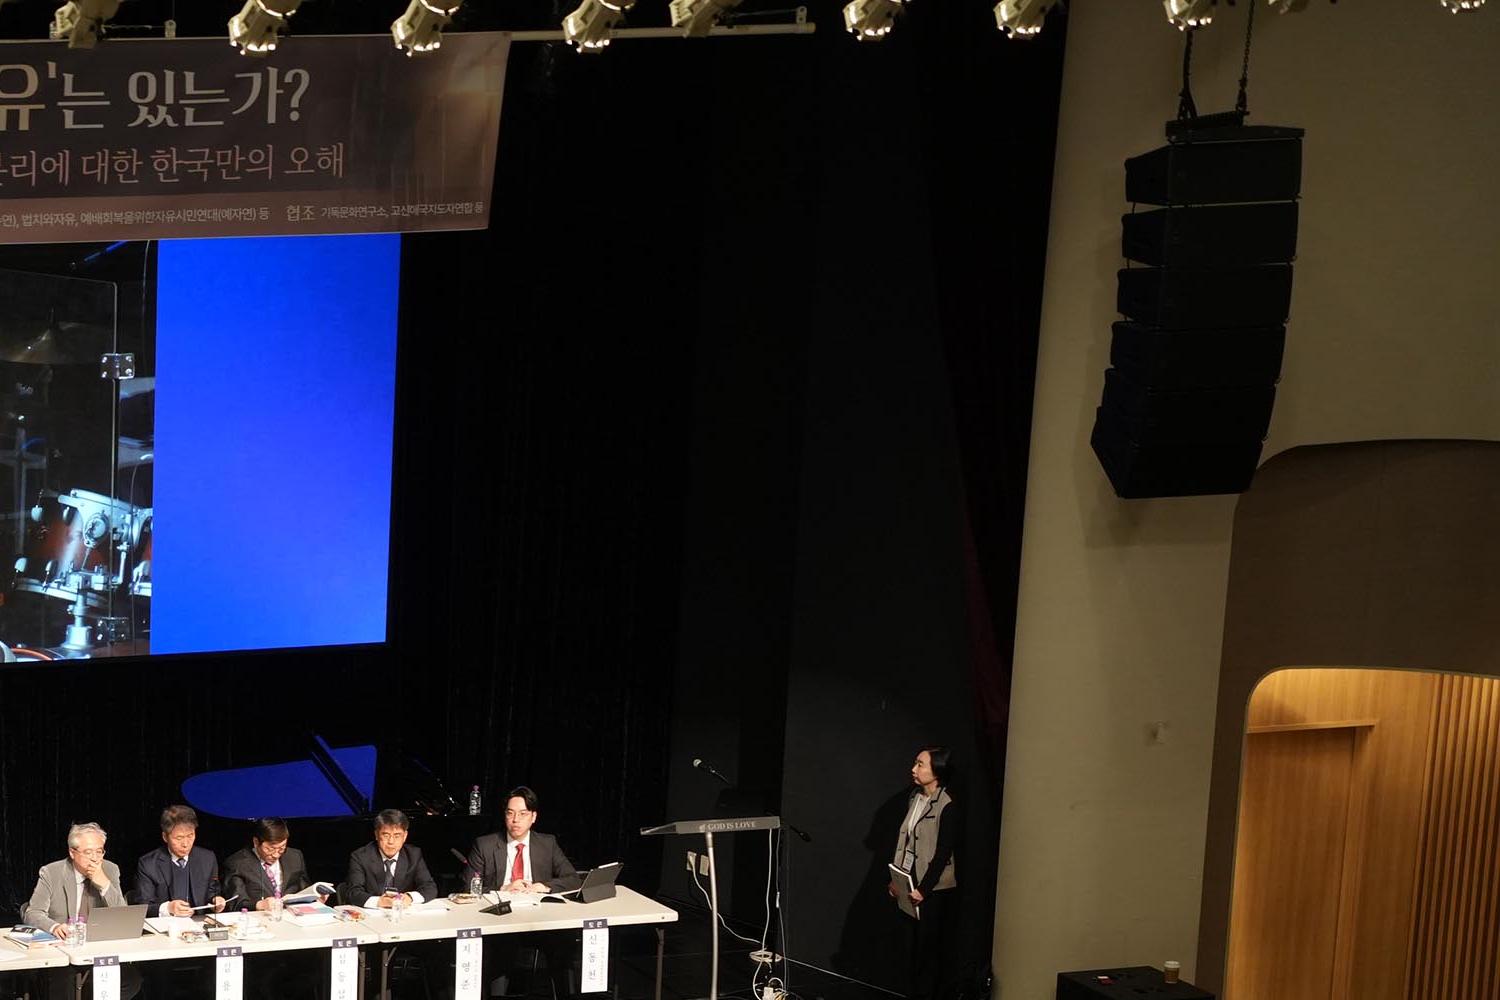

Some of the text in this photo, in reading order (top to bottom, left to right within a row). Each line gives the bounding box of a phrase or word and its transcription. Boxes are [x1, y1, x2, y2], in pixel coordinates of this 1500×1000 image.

[127, 66, 312, 129] 있는가?
[80, 147, 144, 187] 대한
[149, 143, 275, 184] 한국만의
[283, 141, 347, 180] 오해
[259, 207, 270, 221] 등
[285, 204, 317, 222] 협조
[707, 823, 726, 831] GOD
[735, 821, 757, 829] LOVE
